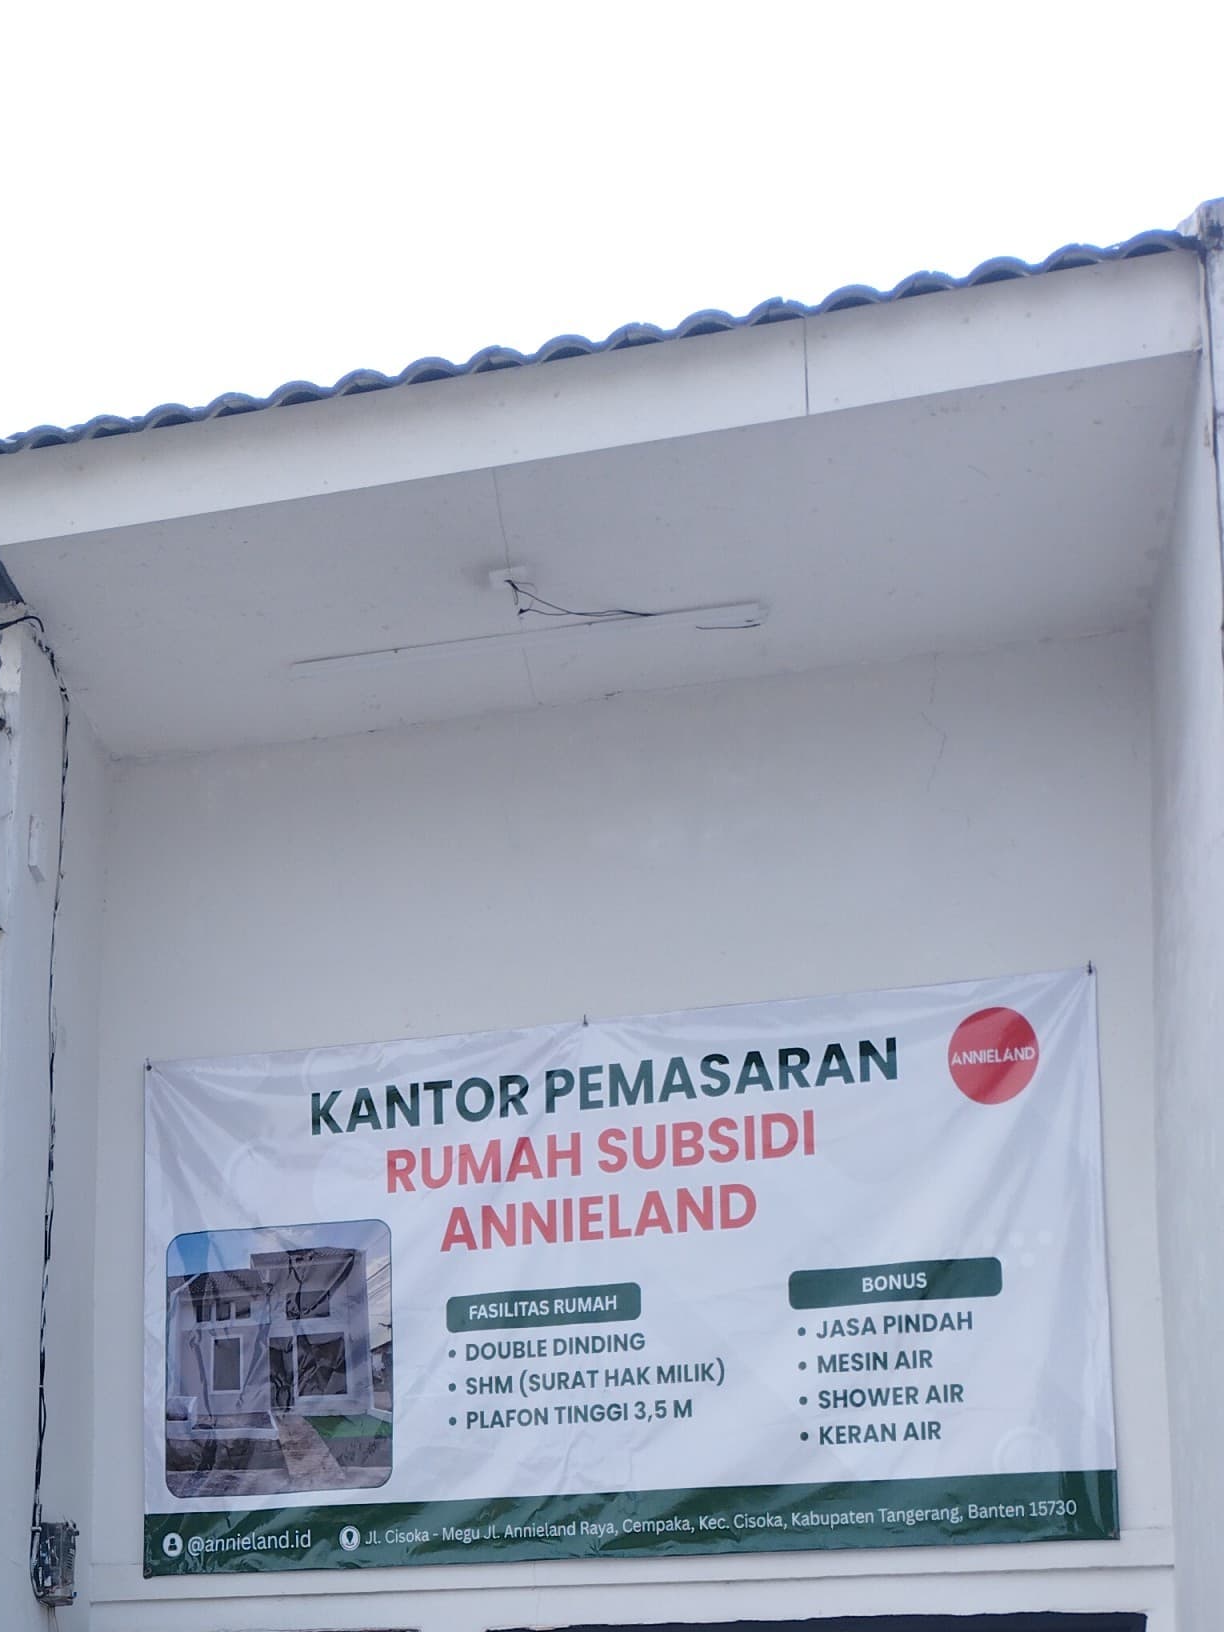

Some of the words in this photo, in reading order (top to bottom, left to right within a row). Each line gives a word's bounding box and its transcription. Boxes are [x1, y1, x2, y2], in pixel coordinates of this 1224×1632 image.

[951, 1046, 1036, 1065] ANNIELAND
[310, 1073, 528, 1136] KANTOR
[544, 1036, 899, 1114] PEMASARAN
[384, 1132, 581, 1194] RUMAH
[598, 1110, 817, 1172] SUBSIDI
[440, 1183, 758, 1253] ANNIELAND
[862, 1272, 928, 1293] BONUS
[468, 1302, 550, 1321] FASILITAS
[554, 1295, 618, 1314] RUMAH
[816, 1317, 877, 1339] JASA
[883, 1311, 973, 1334] PINDAH
[465, 1339, 548, 1362] DOUBLE
[553, 1332, 646, 1356] DINDING
[817, 1351, 888, 1374] MESIN
[895, 1349, 933, 1370] AIR
[466, 1375, 513, 1395] SHM
[519, 1369, 600, 1398] (SURAT
[604, 1366, 651, 1388] HAK
[656, 1357, 726, 1386] MILIK)
[818, 1386, 919, 1410] SHOWER
[925, 1384, 964, 1404] AIR
[466, 1407, 549, 1430] PLAFON
[554, 1402, 628, 1425] TINGGI
[634, 1399, 667, 1423] 3,5
[673, 1399, 693, 1418] M
[819, 1424, 897, 1446] KERAN
[903, 1421, 942, 1441] AIR
[384, 1527, 430, 1544] Cisoka
[442, 1527, 480, 1545] Megu
[504, 1521, 576, 1538] Annieland
[580, 1520, 618, 1537] Raya,
[622, 1516, 695, 1534] Cempaka,
[699, 1515, 730, 1530] Kec.
[733, 1512, 788, 1530] Cisoka,
[791, 1509, 874, 1530] Kabupaten
[878, 1505, 963, 1526] Tangerang,
[968, 1503, 1025, 1520] Banten
[1029, 1500, 1077, 1517] 15730
[187, 1529, 312, 1557] @annieland.id
